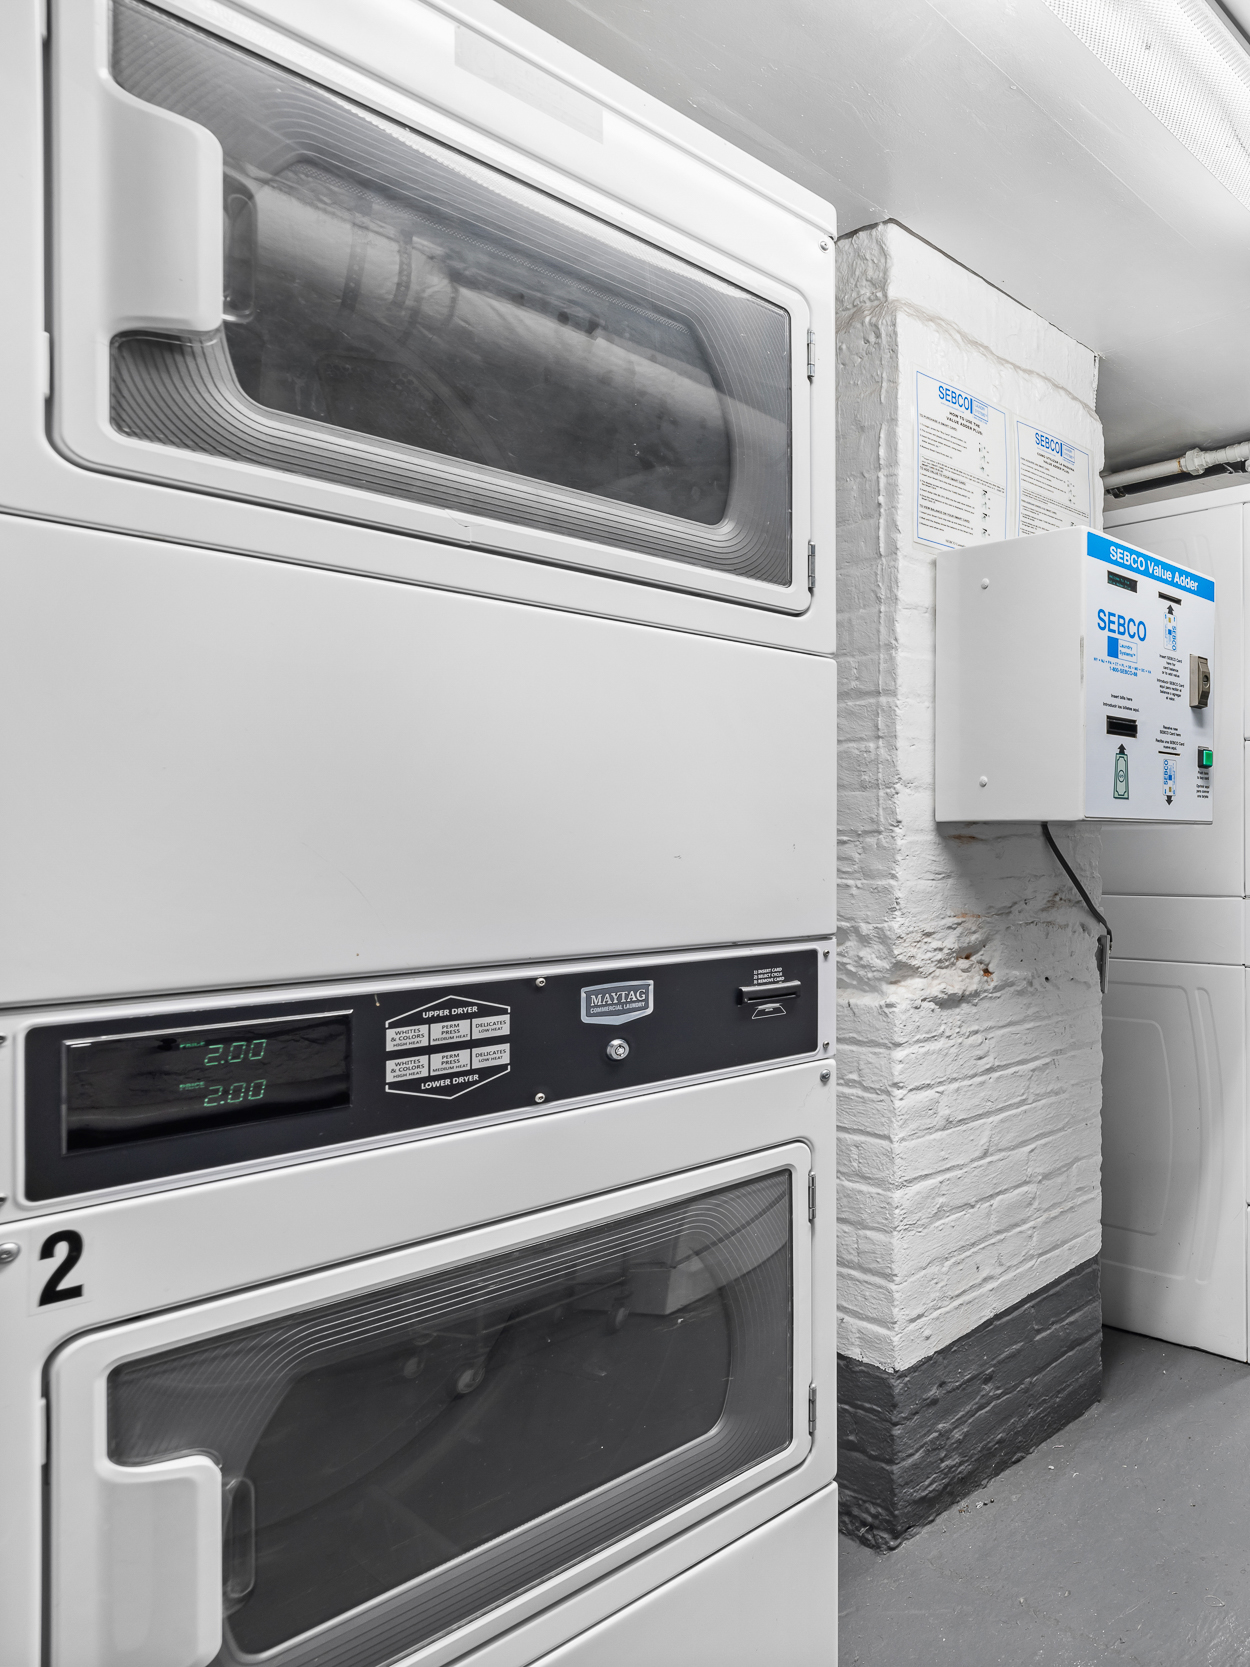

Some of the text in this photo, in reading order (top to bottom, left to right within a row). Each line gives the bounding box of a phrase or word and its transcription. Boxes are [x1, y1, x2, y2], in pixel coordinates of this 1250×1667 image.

[938, 385, 970, 411] SEBCO
[1035, 432, 1060, 455] SEBCO
[1109, 545, 1199, 591] SEBCO Value Adder
[1097, 608, 1147, 642] SEBCO
[590, 989, 646, 1006] MAYTAG
[422, 1006, 478, 1018] UPPER DRYER
[590, 1002, 646, 1013] COMMERCIAL LAUNDRY
[475, 1020, 507, 1028] DELICATES
[394, 1028, 421, 1036] WHITES
[399, 1033, 425, 1041] COLORS
[204, 1039, 267, 1066] 2.00
[475, 1049, 507, 1058] DELICATES
[394, 1059, 421, 1067] WHITES
[399, 1064, 425, 1072] COLORS
[179, 1081, 205, 1090] PRICE
[421, 1074, 479, 1089] LOWER DRYER
[204, 1079, 266, 1106] 2.00
[37, 1229, 84, 1307] 2
